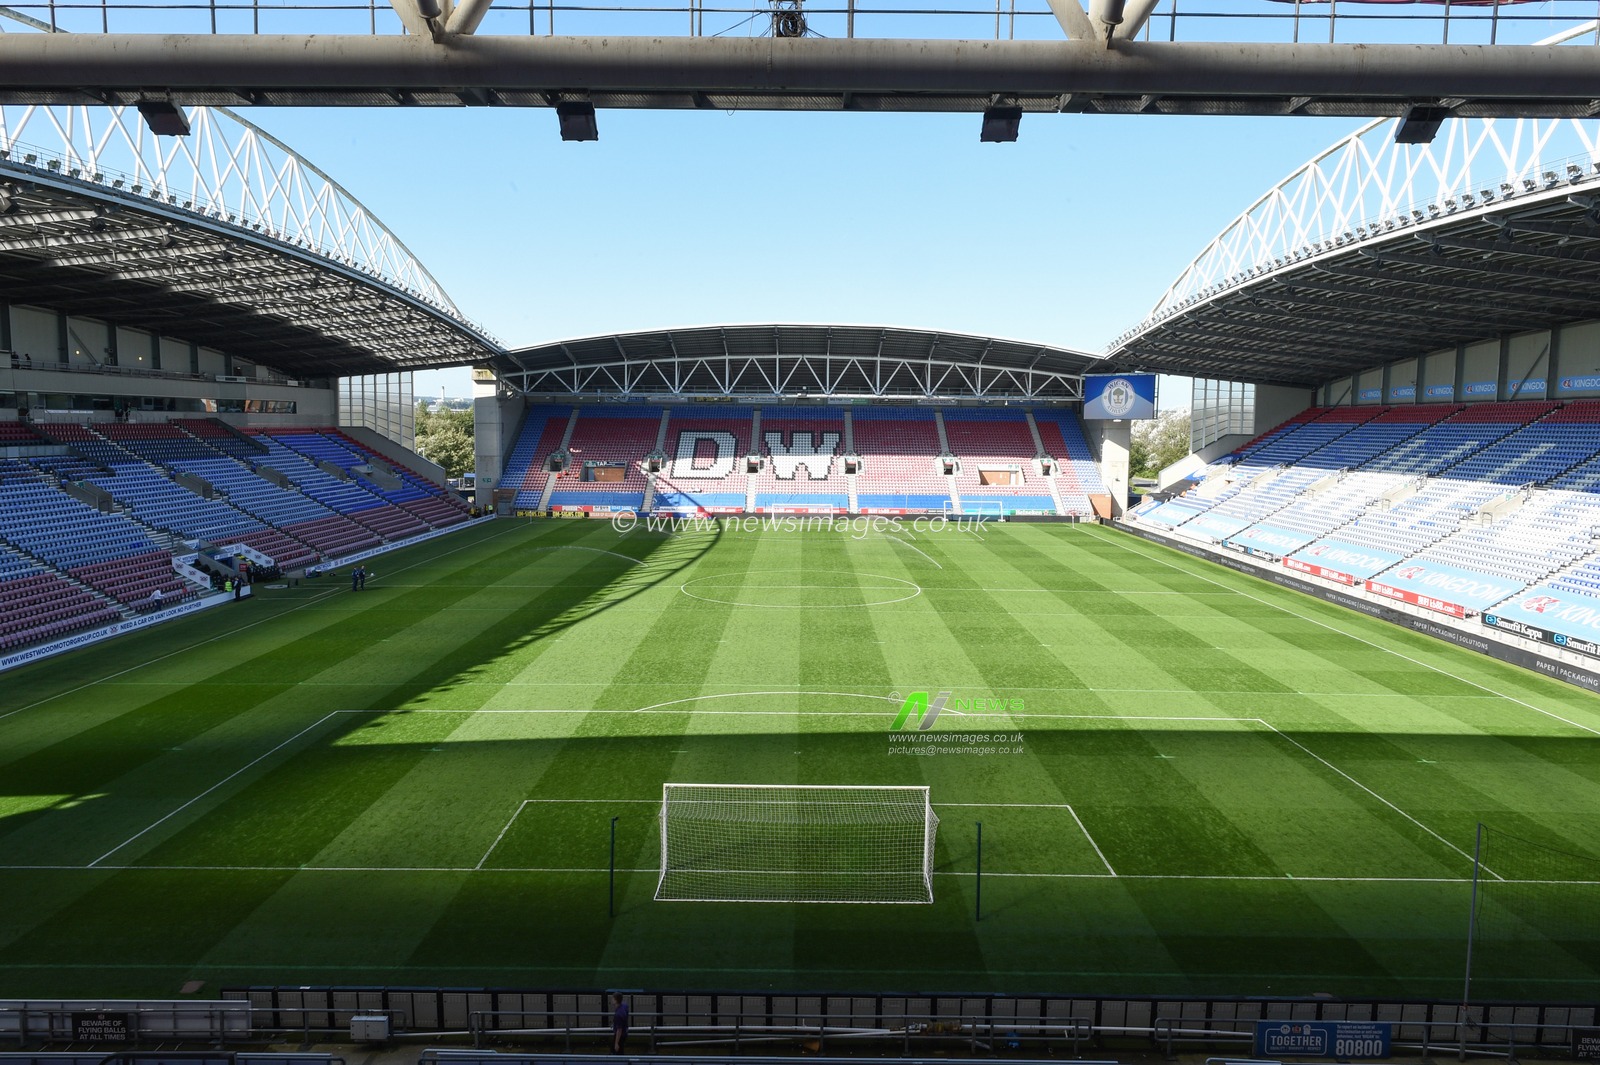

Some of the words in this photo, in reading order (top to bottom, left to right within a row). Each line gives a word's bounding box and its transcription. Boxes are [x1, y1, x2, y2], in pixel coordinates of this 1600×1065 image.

[1108, 380, 1129, 389] WIGAN
[1420, 571, 1512, 601] KINGDOM
[120, 621, 133, 631] NEED
[138, 617, 148, 626] CAR
[148, 615, 155, 623] OR
[166, 609, 178, 618] LOOK
[1496, 617, 1521, 633] Smurfit
[1521, 624, 1543, 640] Kappa
[1413, 620, 1427, 629] PAPER
[1430, 626, 1456, 640] PACKAGING
[1459, 635, 1488, 650] SOLUTIONS
[1566, 637, 1597, 655] Smurfit
[1, 629, 109, 667] WWW.WESTWOODMOTORGROUP.CO.UK
[1536, 660, 1555, 672] PAPER
[1560, 669, 1599, 687] PACKAGING
[1270, 1035, 1322, 1047] TOGETHER
[1336, 1039, 1383, 1057] 80800
